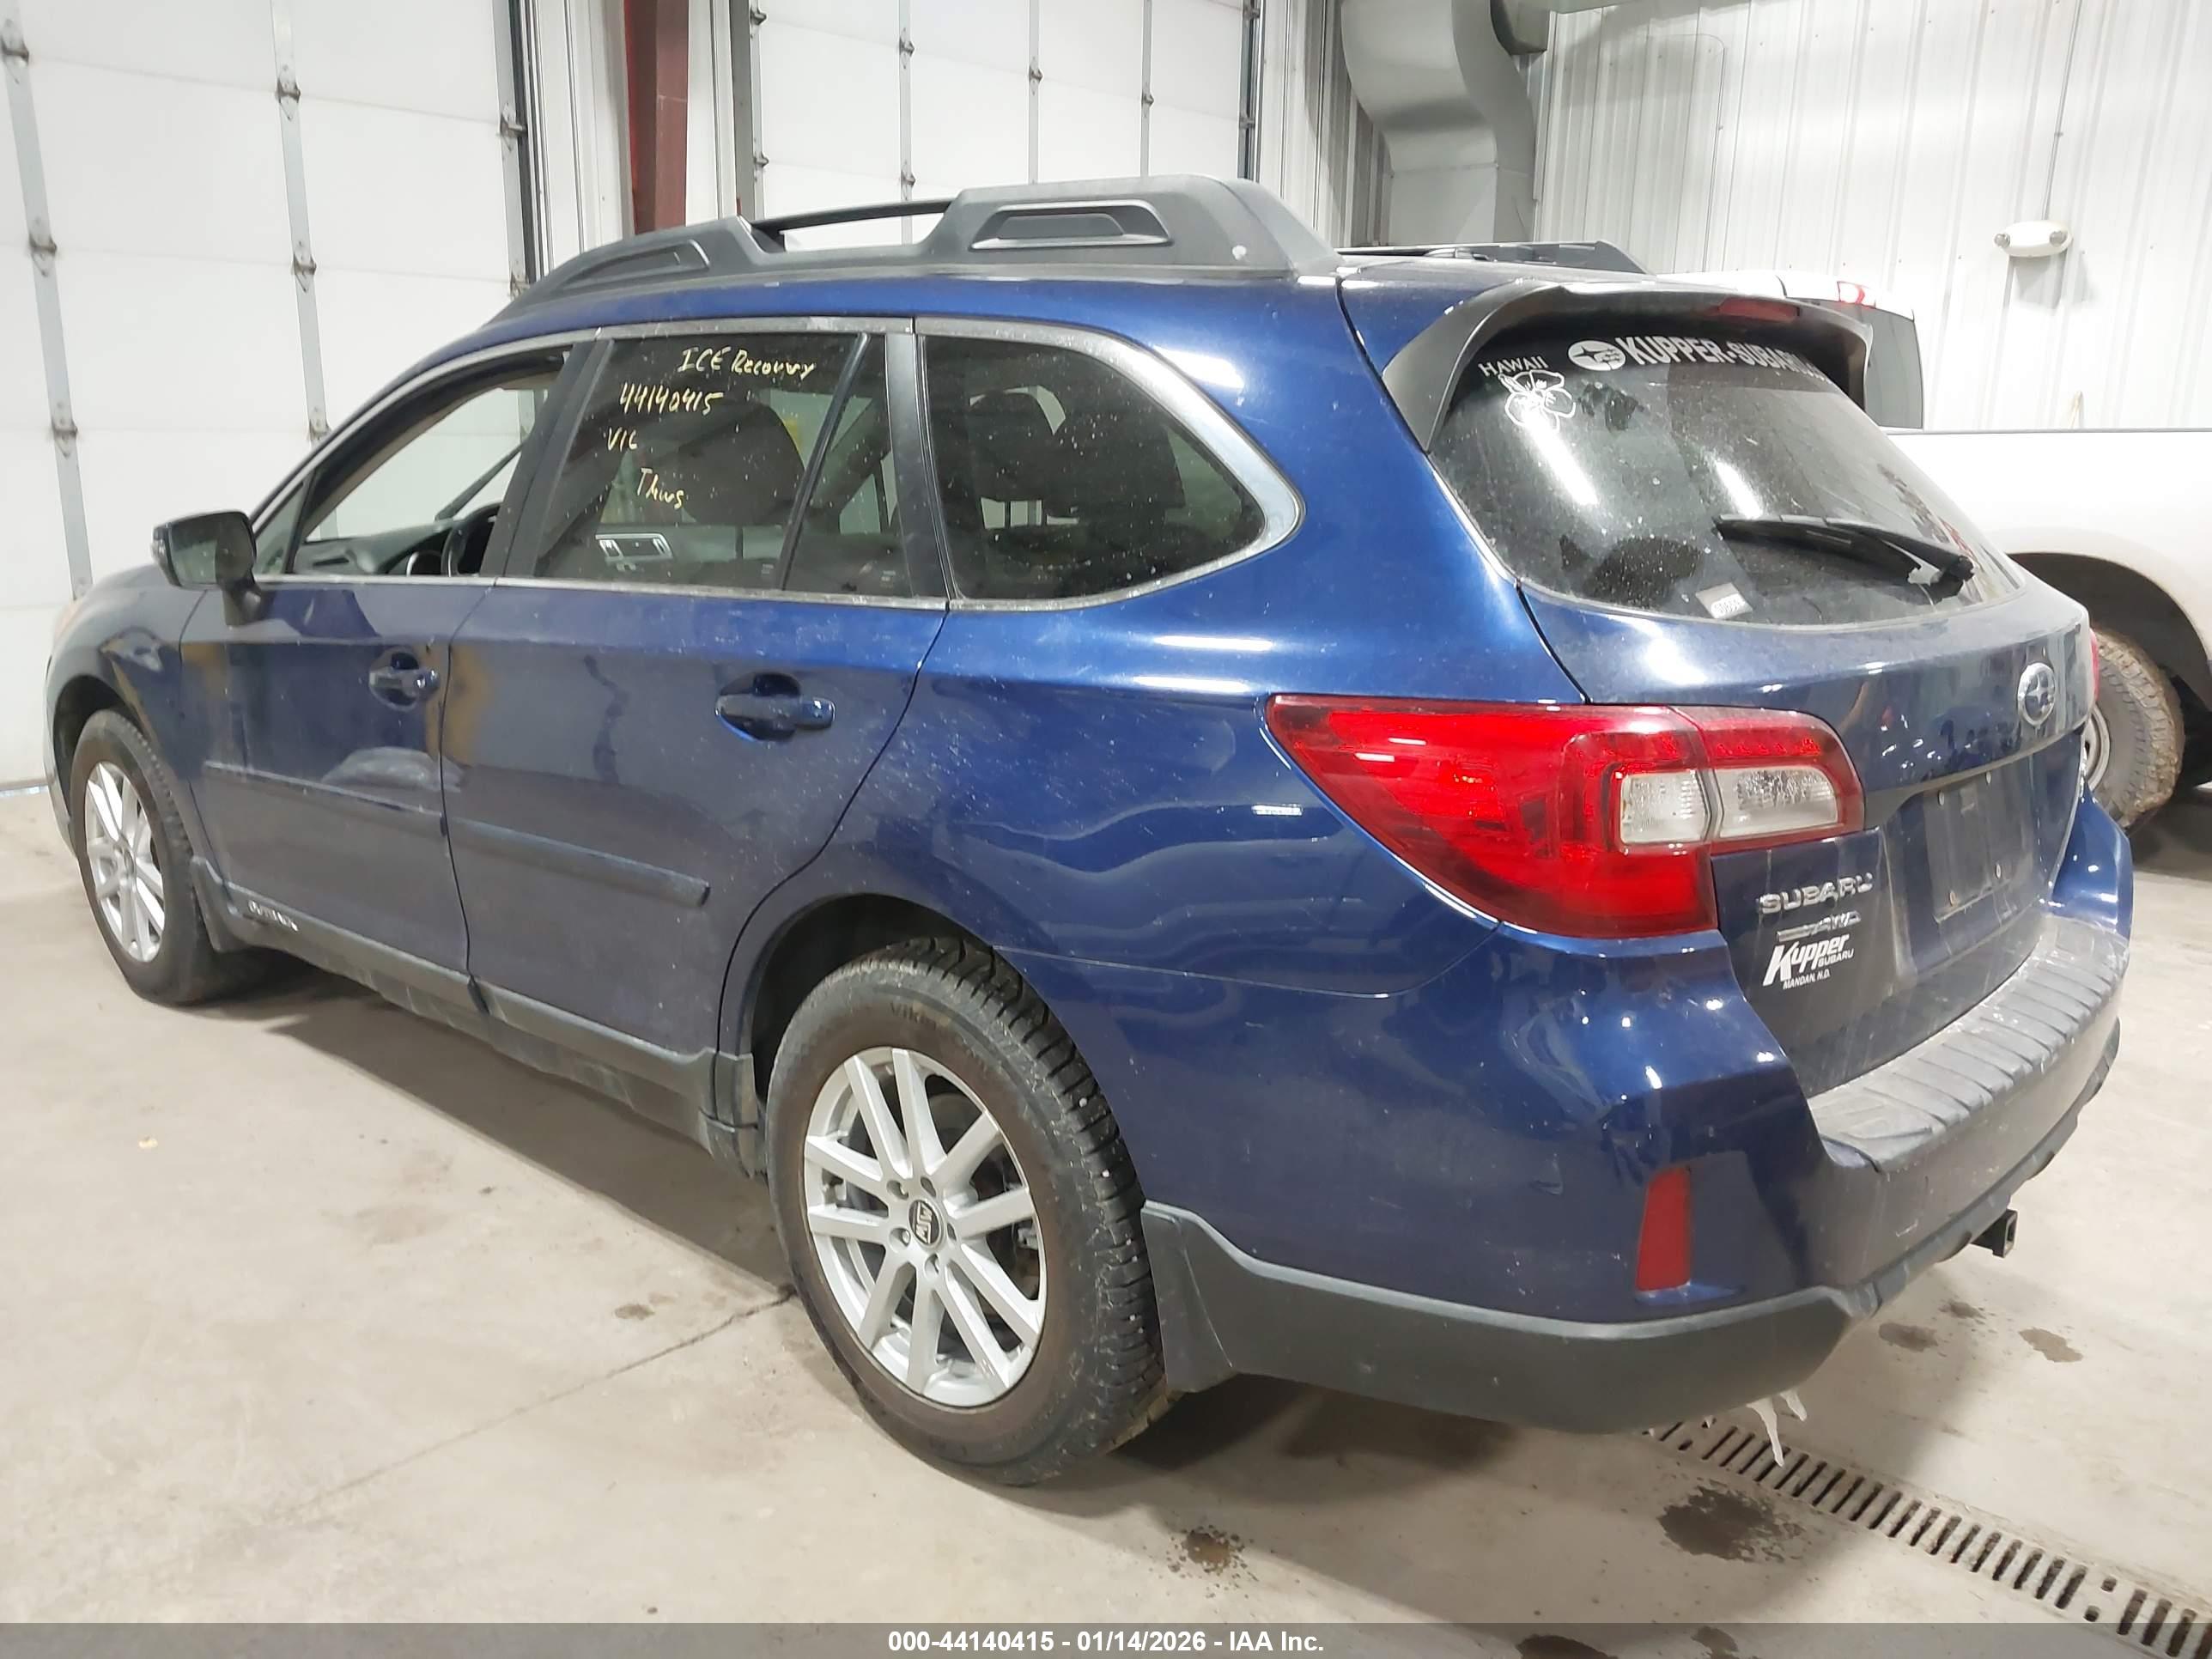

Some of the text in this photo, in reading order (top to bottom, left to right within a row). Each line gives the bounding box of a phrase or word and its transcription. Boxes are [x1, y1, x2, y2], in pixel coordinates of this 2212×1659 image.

[678, 346, 731, 372] ICE
[1478, 356, 1549, 378] HAWAII
[619, 382, 725, 415] 44140415
[1756, 872, 1873, 914] SUBARU
[1762, 934, 1850, 987] Kupper
[1818, 948, 1855, 968] SUBARU
